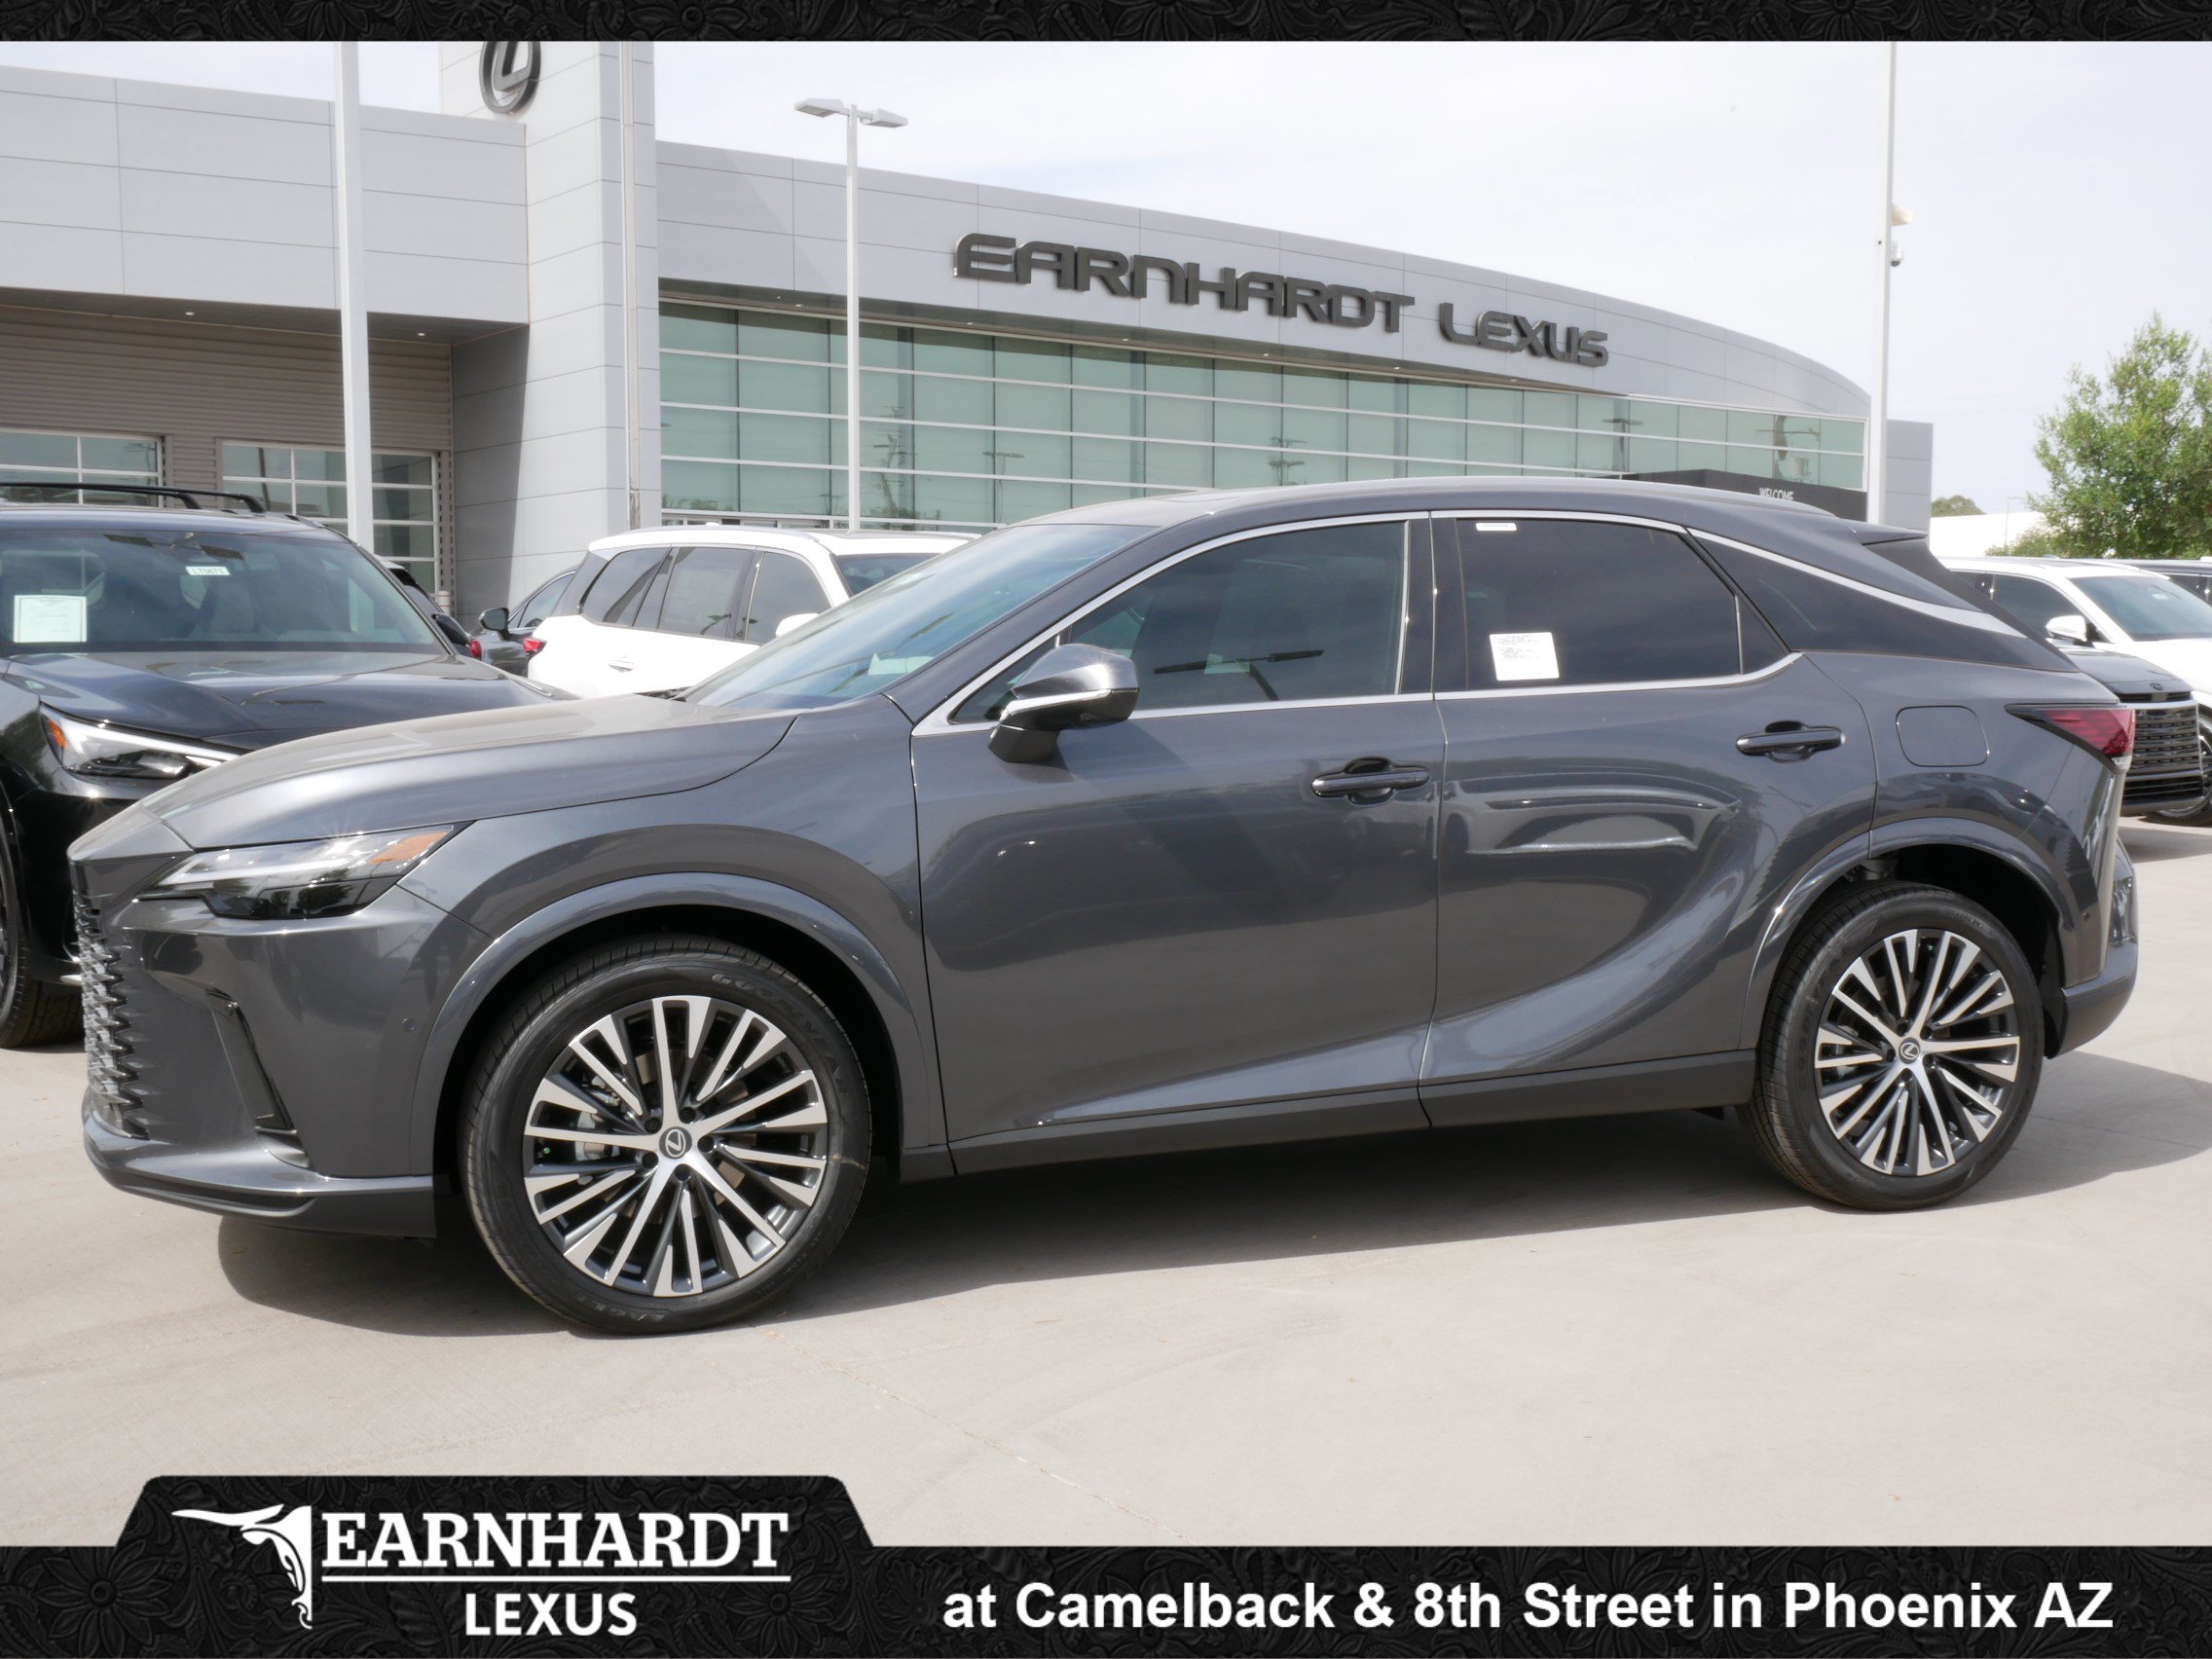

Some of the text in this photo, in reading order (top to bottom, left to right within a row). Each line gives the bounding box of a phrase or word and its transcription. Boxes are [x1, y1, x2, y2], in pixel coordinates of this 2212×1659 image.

[954, 233, 1608, 367] EARNHARDT LEXUS
[1759, 488, 1794, 500] WELCOME
